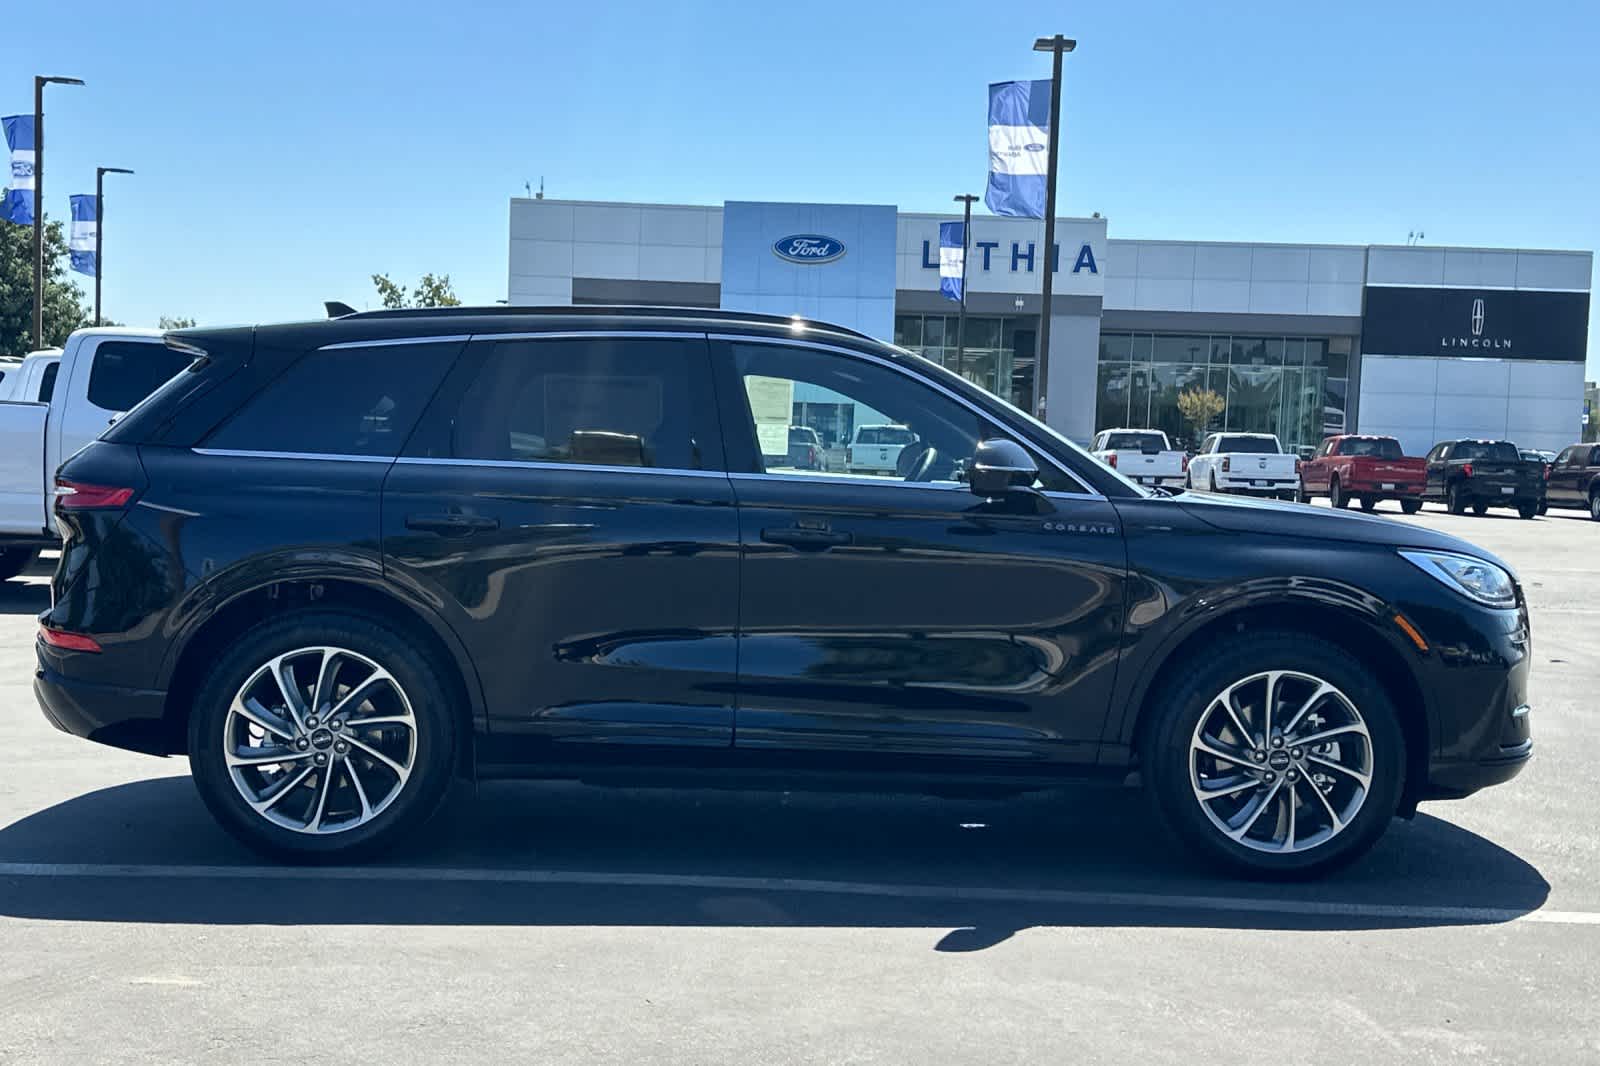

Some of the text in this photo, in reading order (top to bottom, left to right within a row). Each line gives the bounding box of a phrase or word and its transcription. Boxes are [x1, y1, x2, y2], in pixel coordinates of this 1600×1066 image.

[789, 239, 829, 256] Ford
[922, 240, 1097, 273] LTHIA
[1442, 337, 1511, 348] LINCOLN
